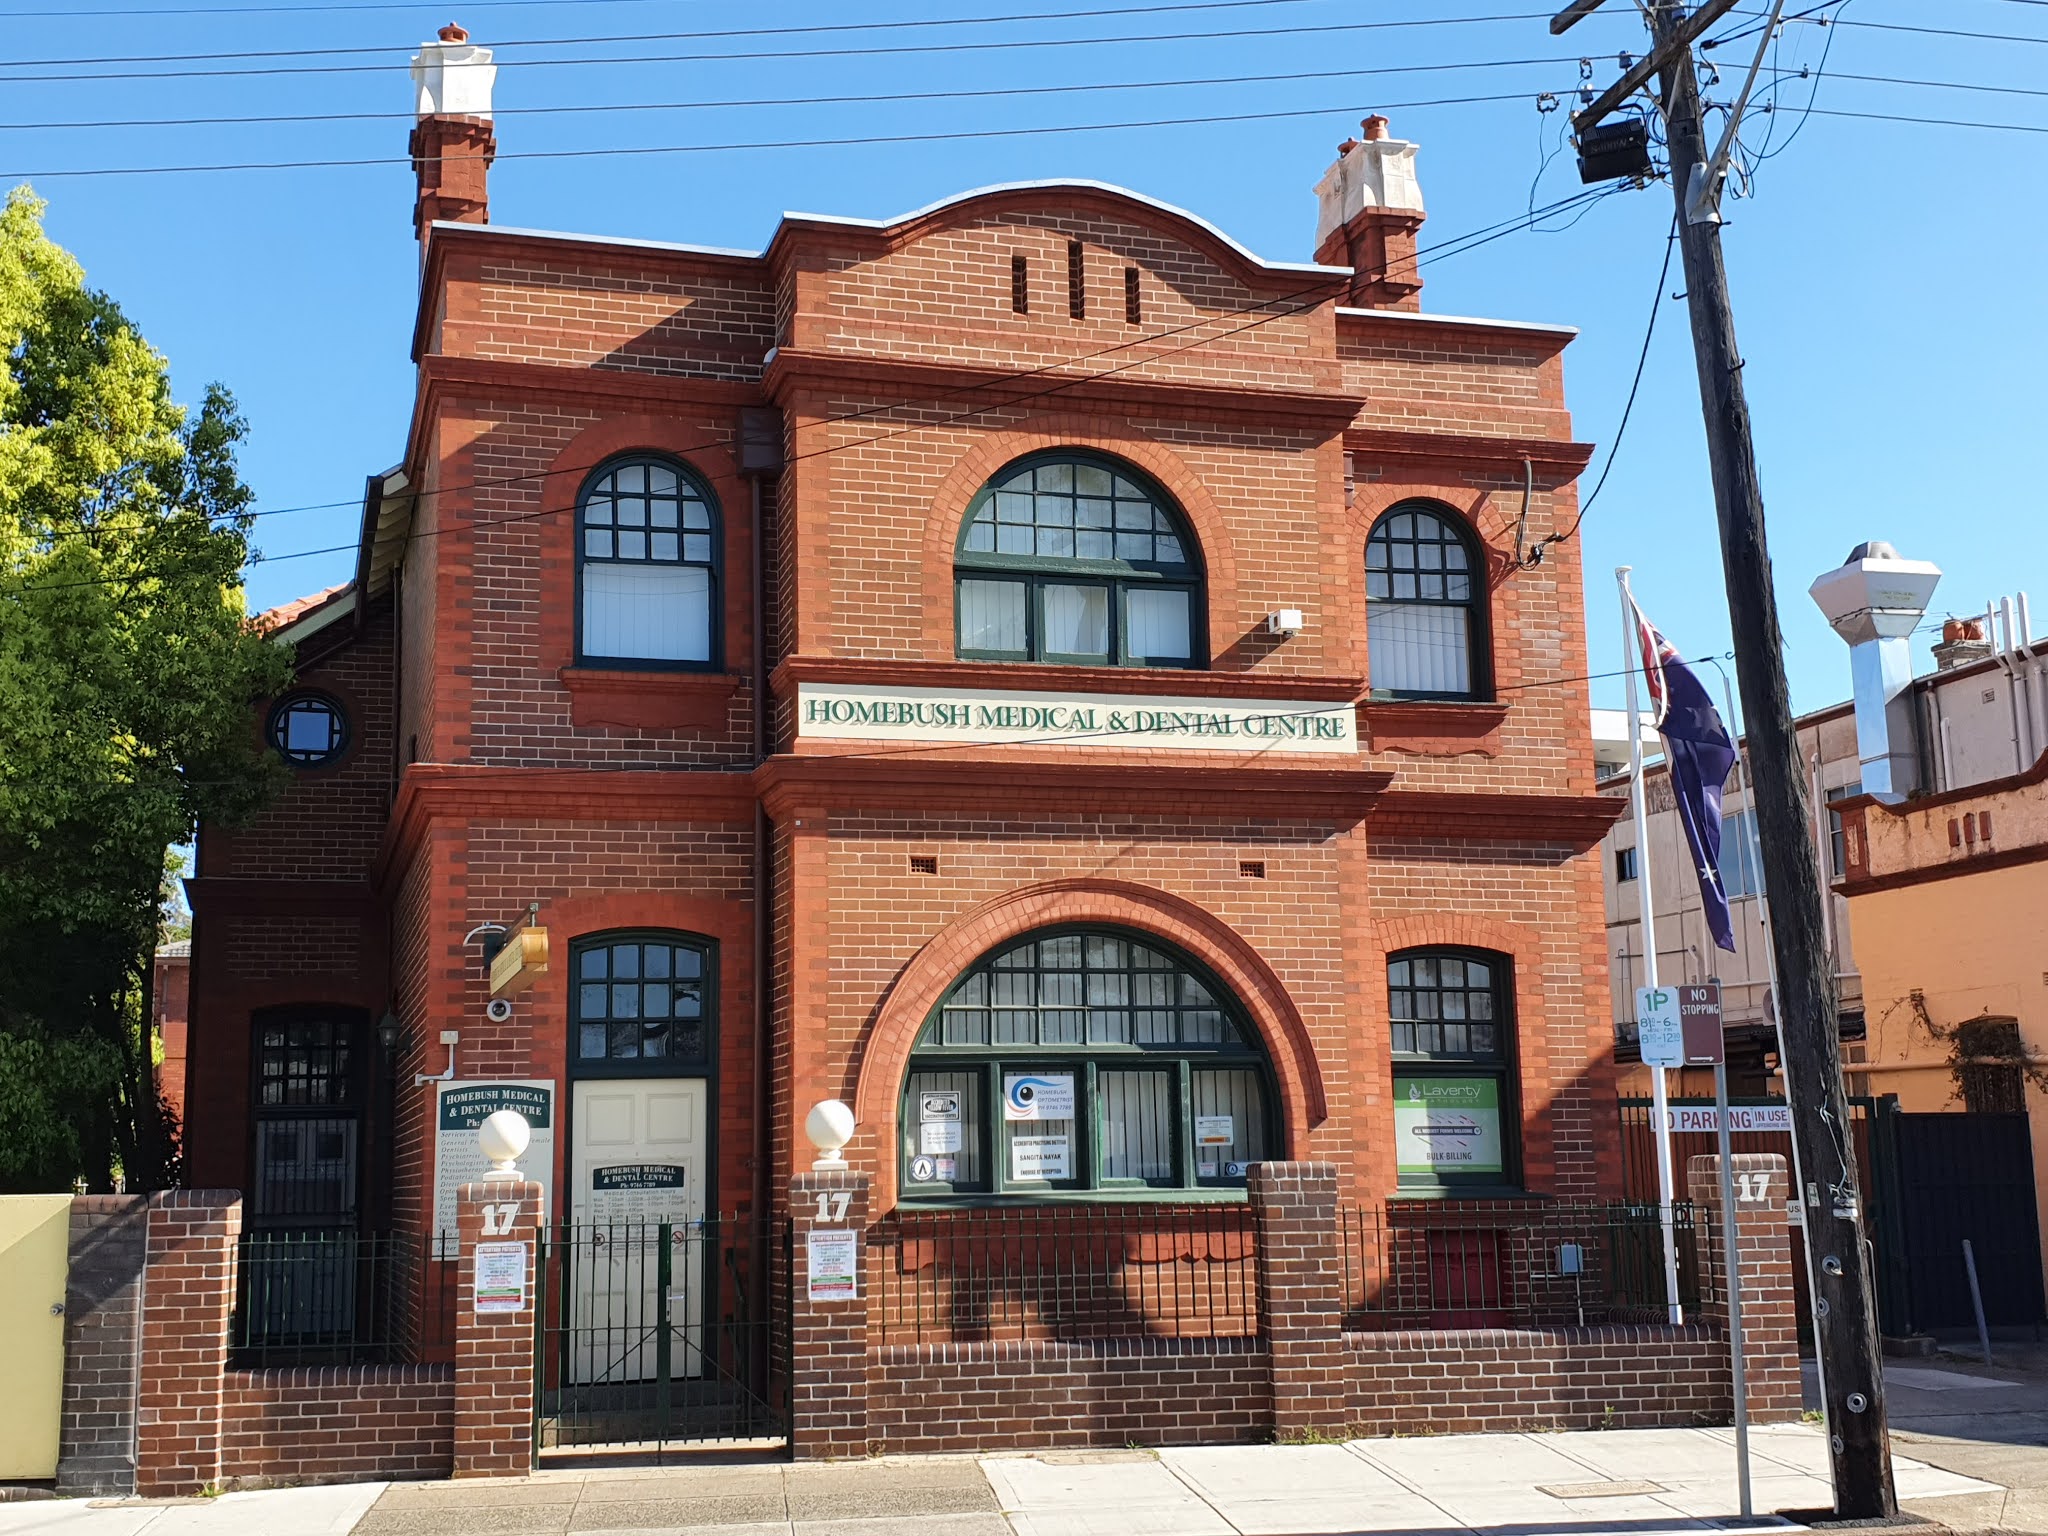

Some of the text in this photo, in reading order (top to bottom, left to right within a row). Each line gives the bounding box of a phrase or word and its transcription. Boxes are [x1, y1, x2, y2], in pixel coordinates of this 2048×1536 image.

[805, 699, 1347, 739] HOMEBUSH MEDICAL & DENTAL CENTRE
[1691, 989, 1707, 1001] NO
[1645, 993, 1669, 1011] 1P
[1682, 1004, 1719, 1015] STOPPING
[446, 1090, 546, 1105] HOMEBUSH MEDICAL
[1423, 1084, 1481, 1099] Laverty
[449, 1103, 542, 1118] & DENTAL CENTRE
[1754, 1110, 1788, 1122] IN USE
[466, 1119, 480, 1127] Ph:
[441, 1139, 467, 1147] General
[1426, 1151, 1473, 1161] BULK-BILLING
[441, 1160, 485, 1168] Psychologists
[602, 1165, 676, 1176] HOMEBUSH MEDICAL
[603, 1172, 673, 1184] & DENTAL CENTRE
[1738, 1174, 1770, 1202] 17
[816, 1193, 851, 1222] 17
[481, 1204, 520, 1236] 17
